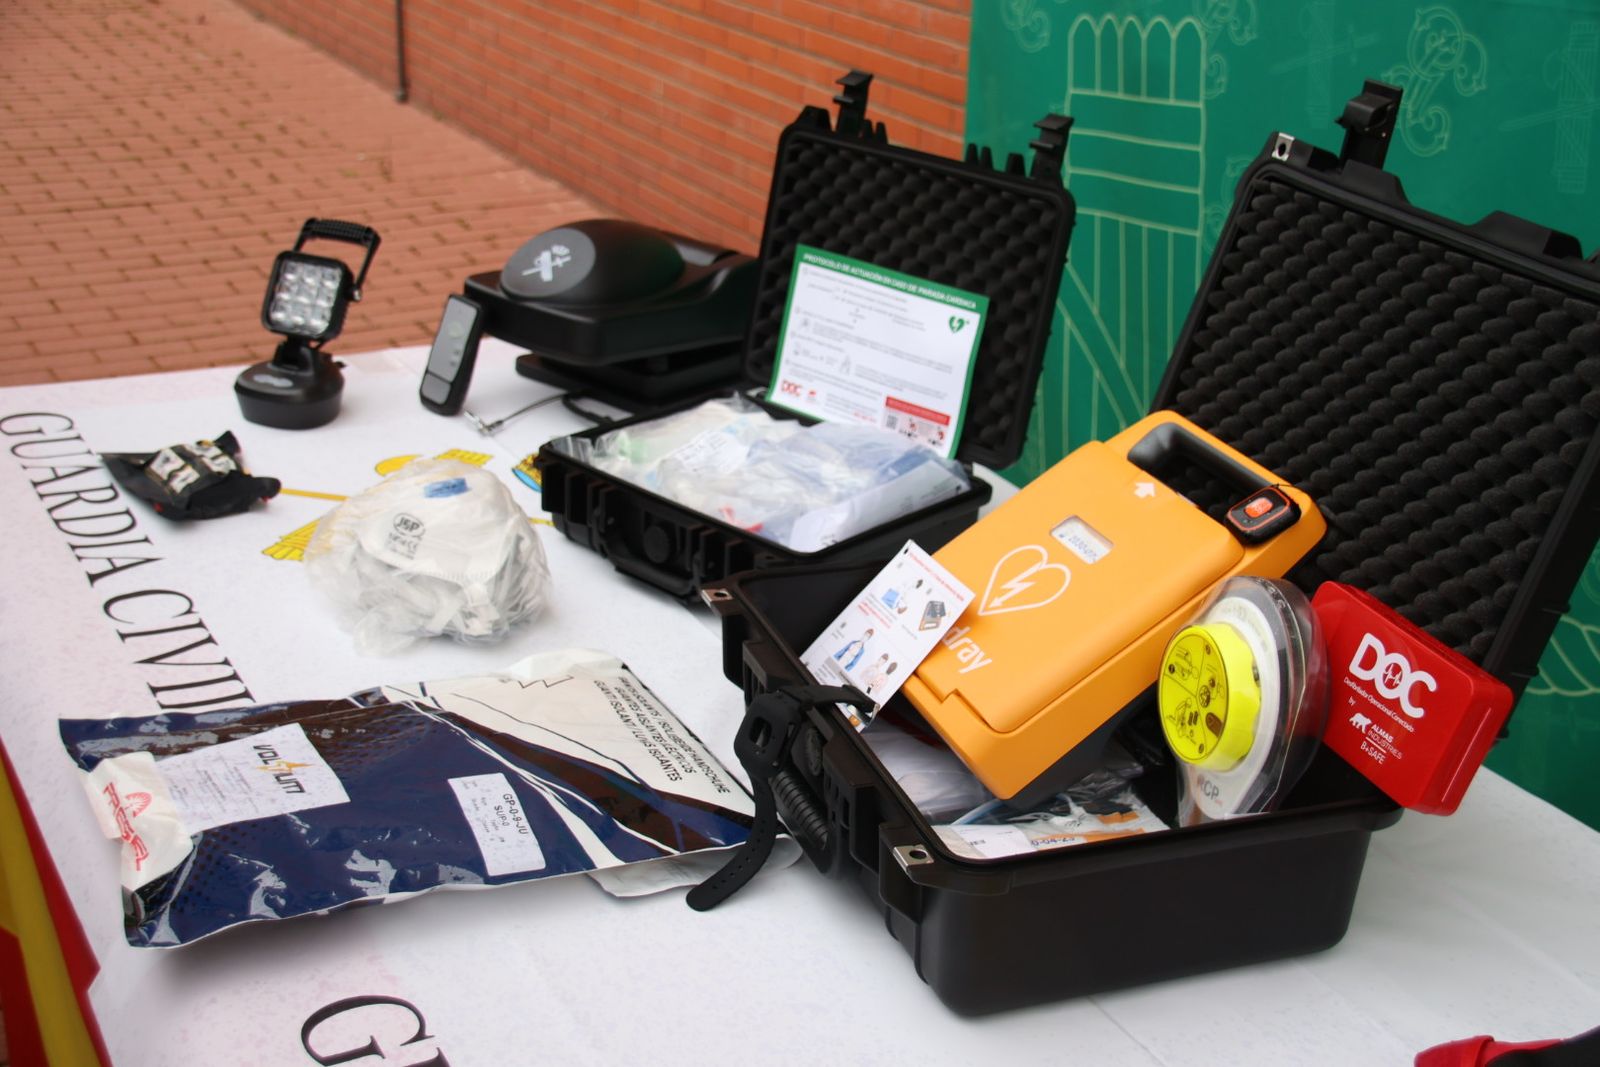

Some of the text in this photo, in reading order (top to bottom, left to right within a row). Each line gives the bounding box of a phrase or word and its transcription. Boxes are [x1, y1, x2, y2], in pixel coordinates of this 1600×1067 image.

[0, 412, 163, 588] GUARDIA
[1349, 632, 1437, 718] DOC
[1368, 731, 1402, 760] INDUSTRIES
[1371, 724, 1394, 743] ALMAS
